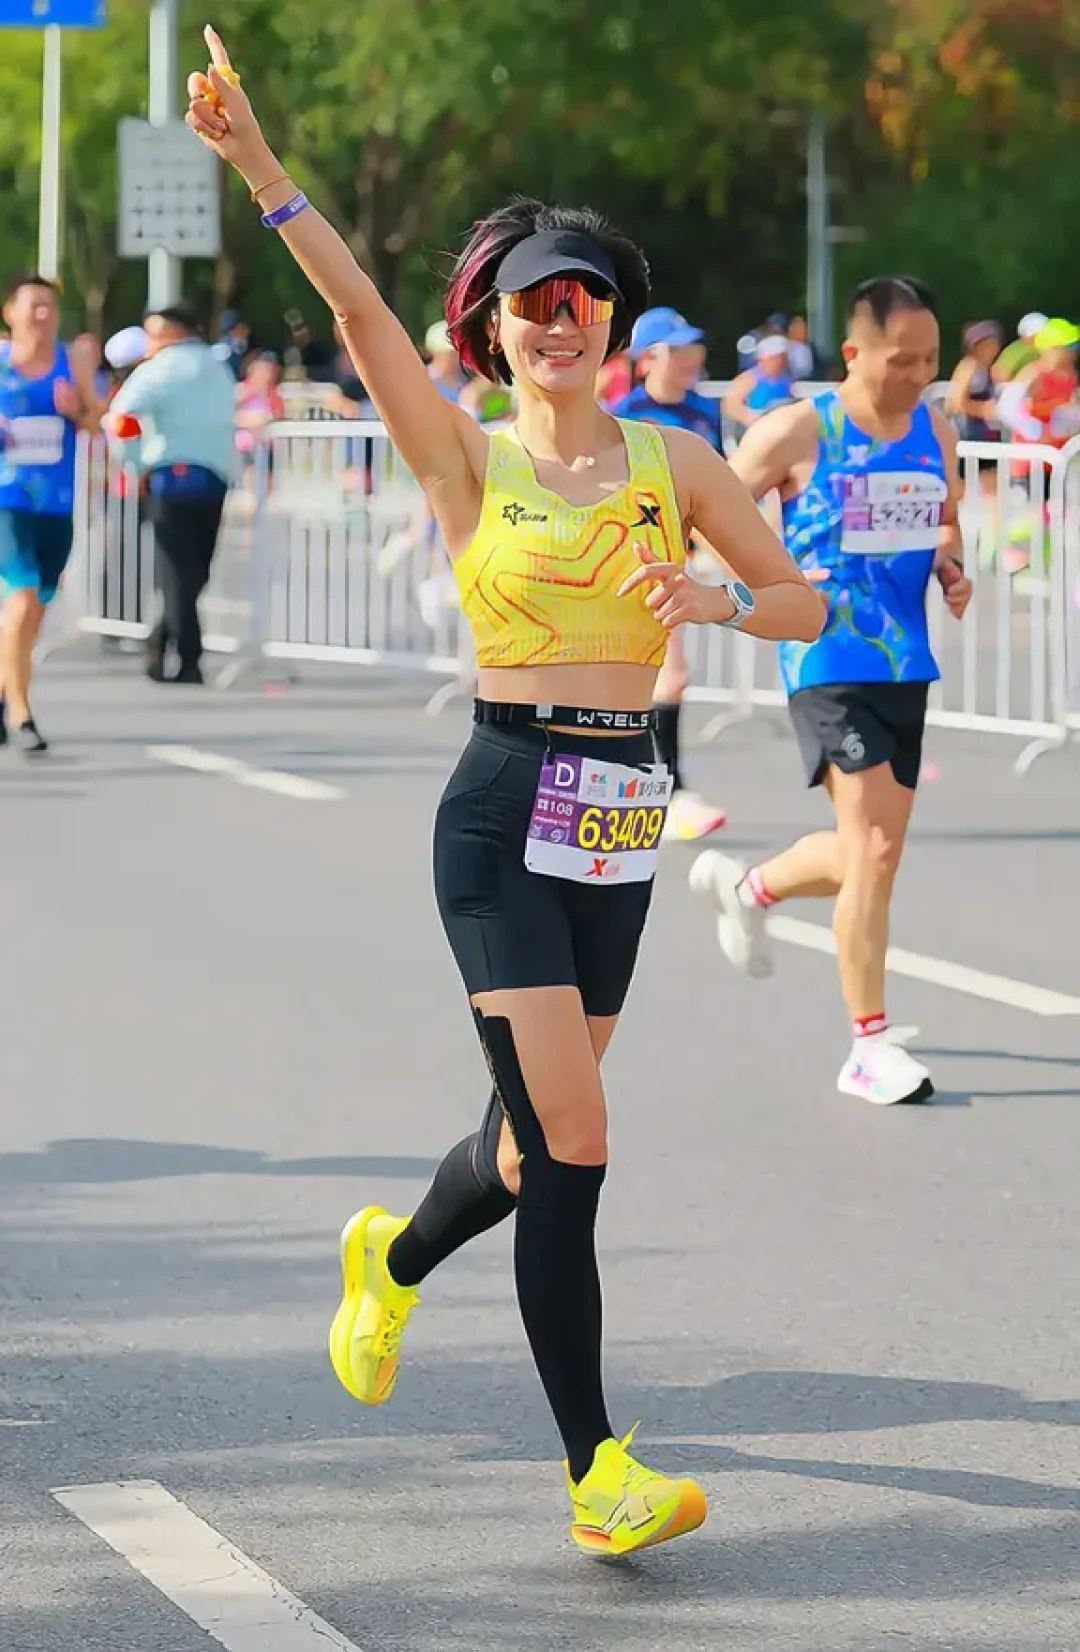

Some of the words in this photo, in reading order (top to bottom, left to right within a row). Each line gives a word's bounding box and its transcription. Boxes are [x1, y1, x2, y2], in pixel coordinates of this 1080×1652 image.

[554, 763, 575, 786] D
[551, 801, 573, 816] 108
[577, 807, 663, 851] 63409
